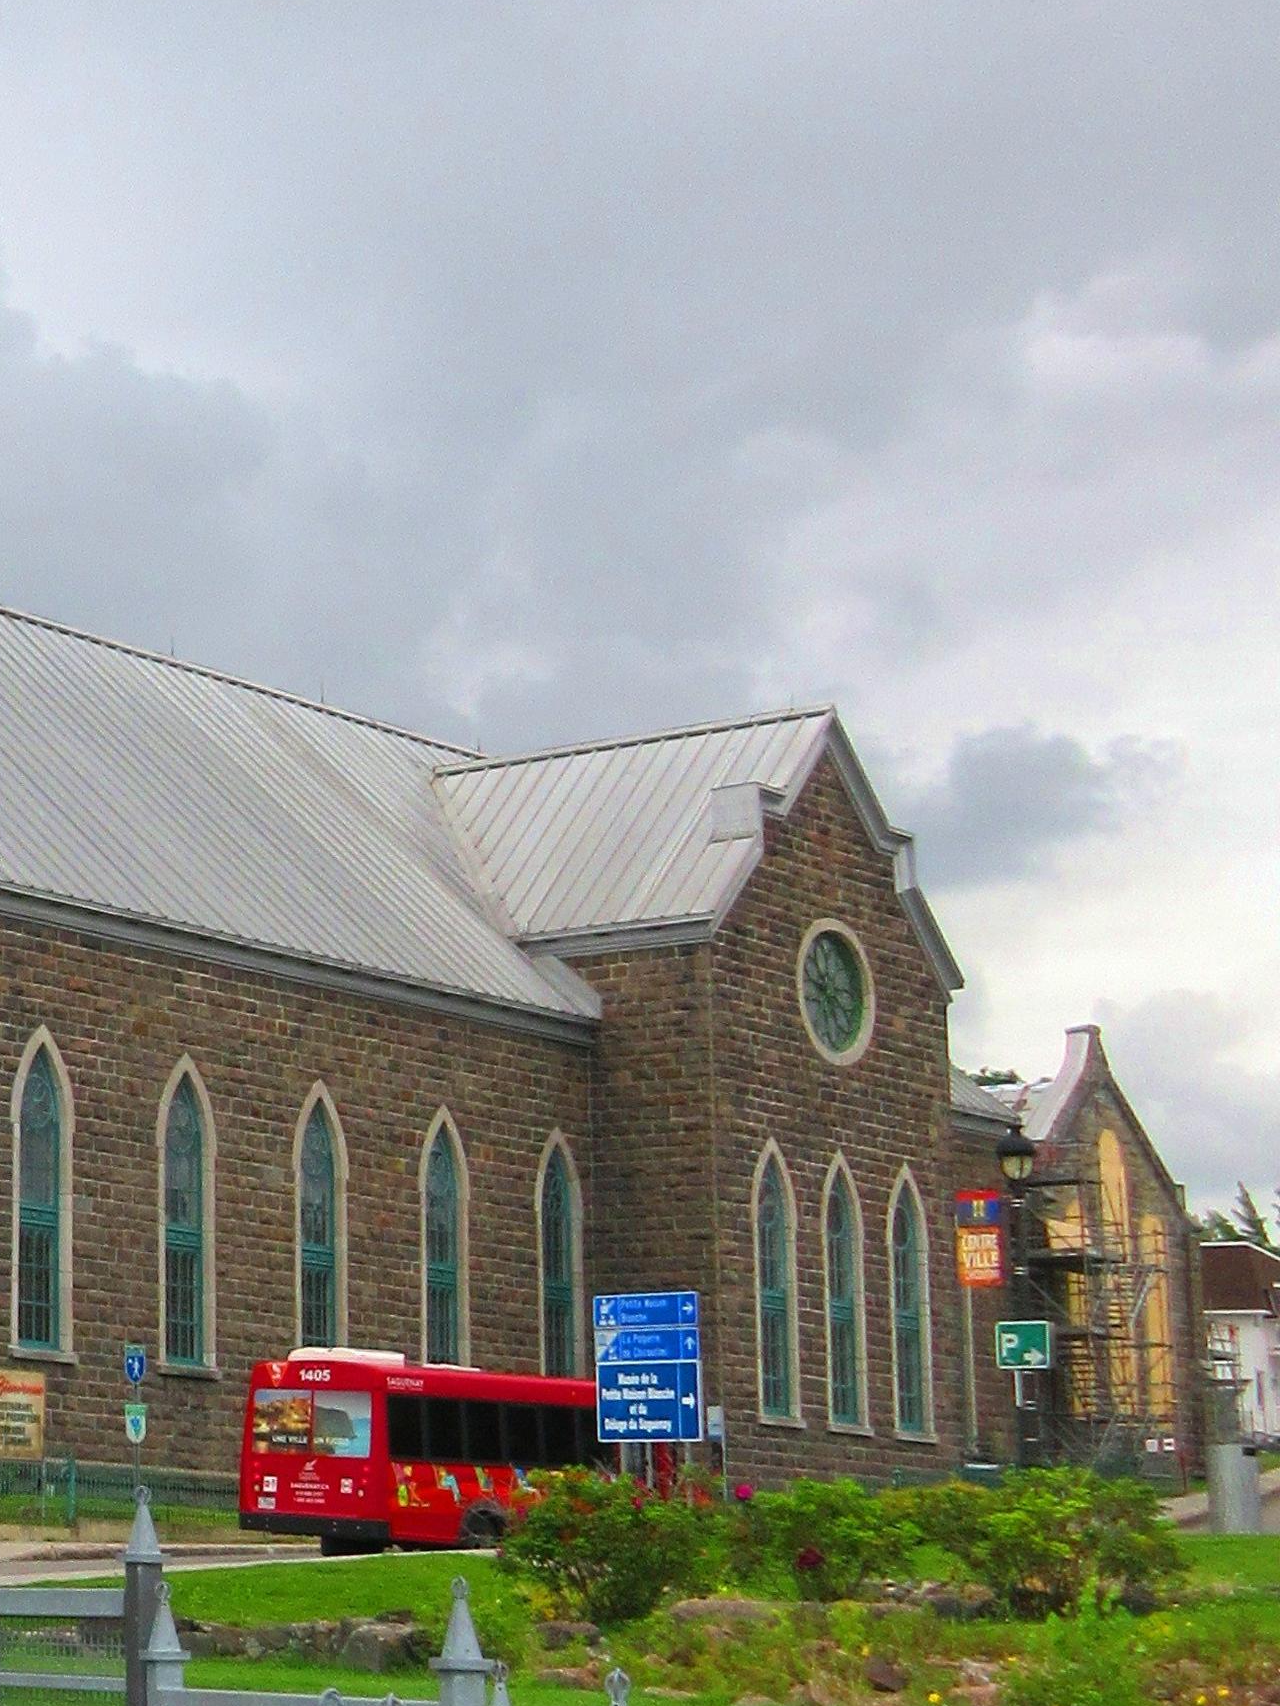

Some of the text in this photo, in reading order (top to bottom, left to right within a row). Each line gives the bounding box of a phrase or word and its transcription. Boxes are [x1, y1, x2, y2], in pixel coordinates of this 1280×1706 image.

[963, 1251, 999, 1268] VILLE
[1000, 1333, 1019, 1359] P
[299, 1369, 331, 1382] 1405
[641, 1373, 650, 1384] de
[650, 1373, 658, 1384] la
